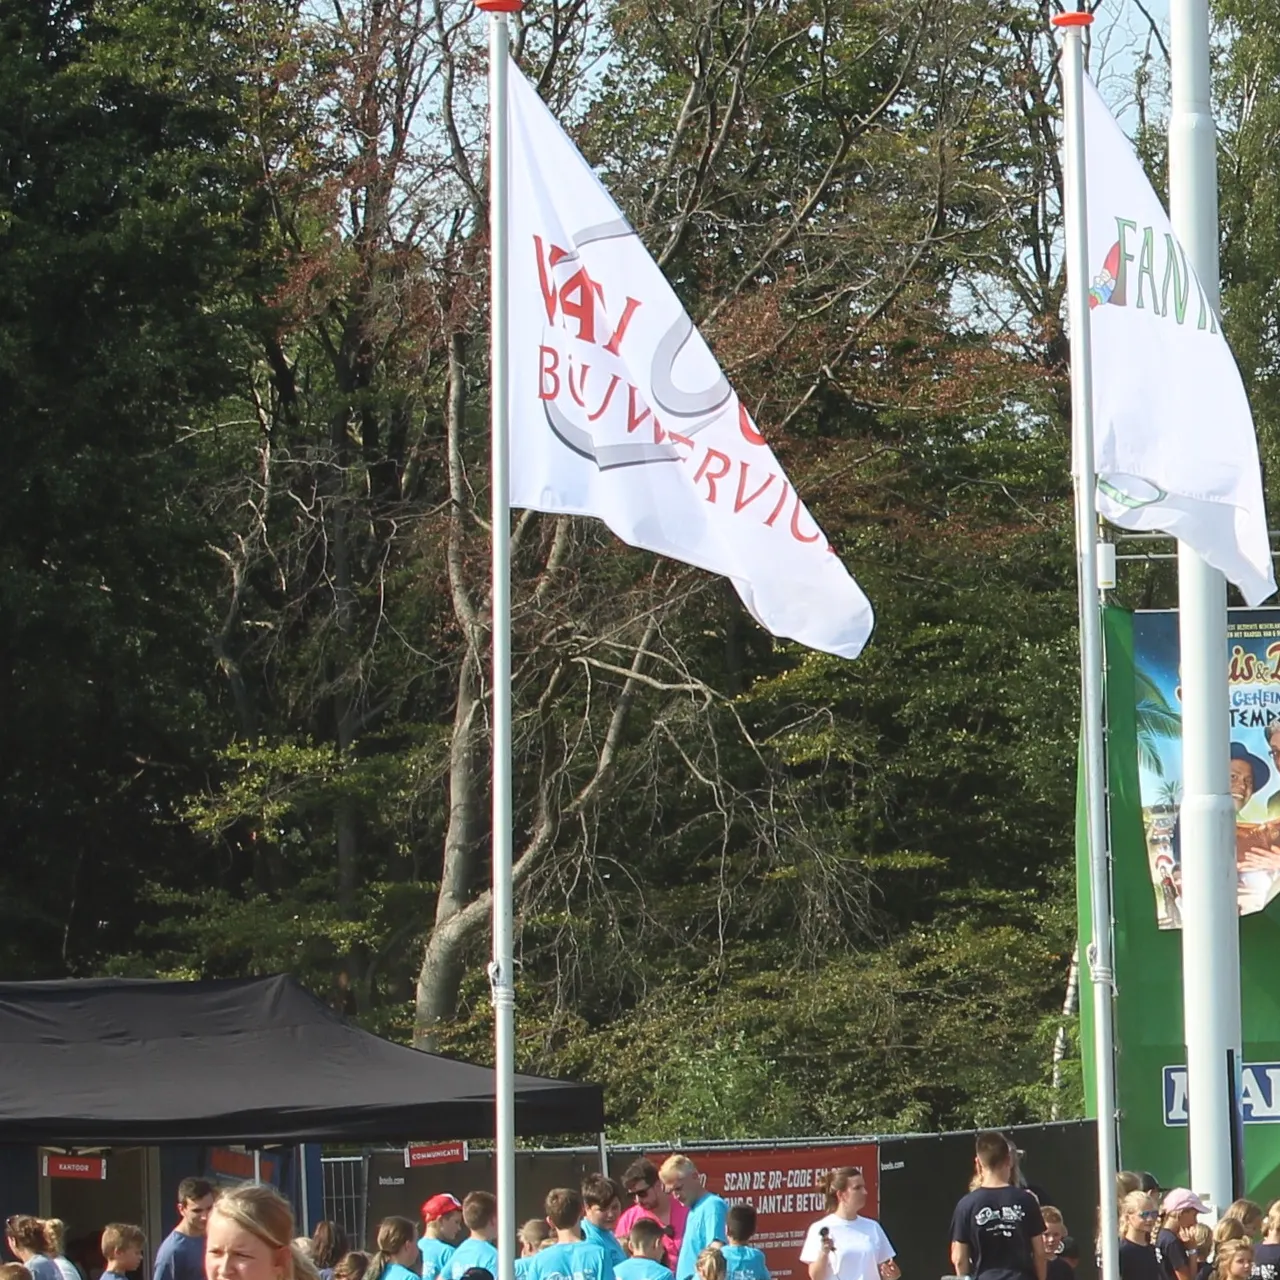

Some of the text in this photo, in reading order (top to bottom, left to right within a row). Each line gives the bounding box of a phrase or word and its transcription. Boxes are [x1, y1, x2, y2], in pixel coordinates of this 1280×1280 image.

[411, 1149, 460, 1161] COMMUNICATIE
[59, 1163, 89, 1172] KANTOOR
[724, 1171, 750, 1191] SCAN
[753, 1170, 766, 1190] DE
[768, 1167, 812, 1191] QR-CODE
[756, 1194, 794, 1214] JANTJE
